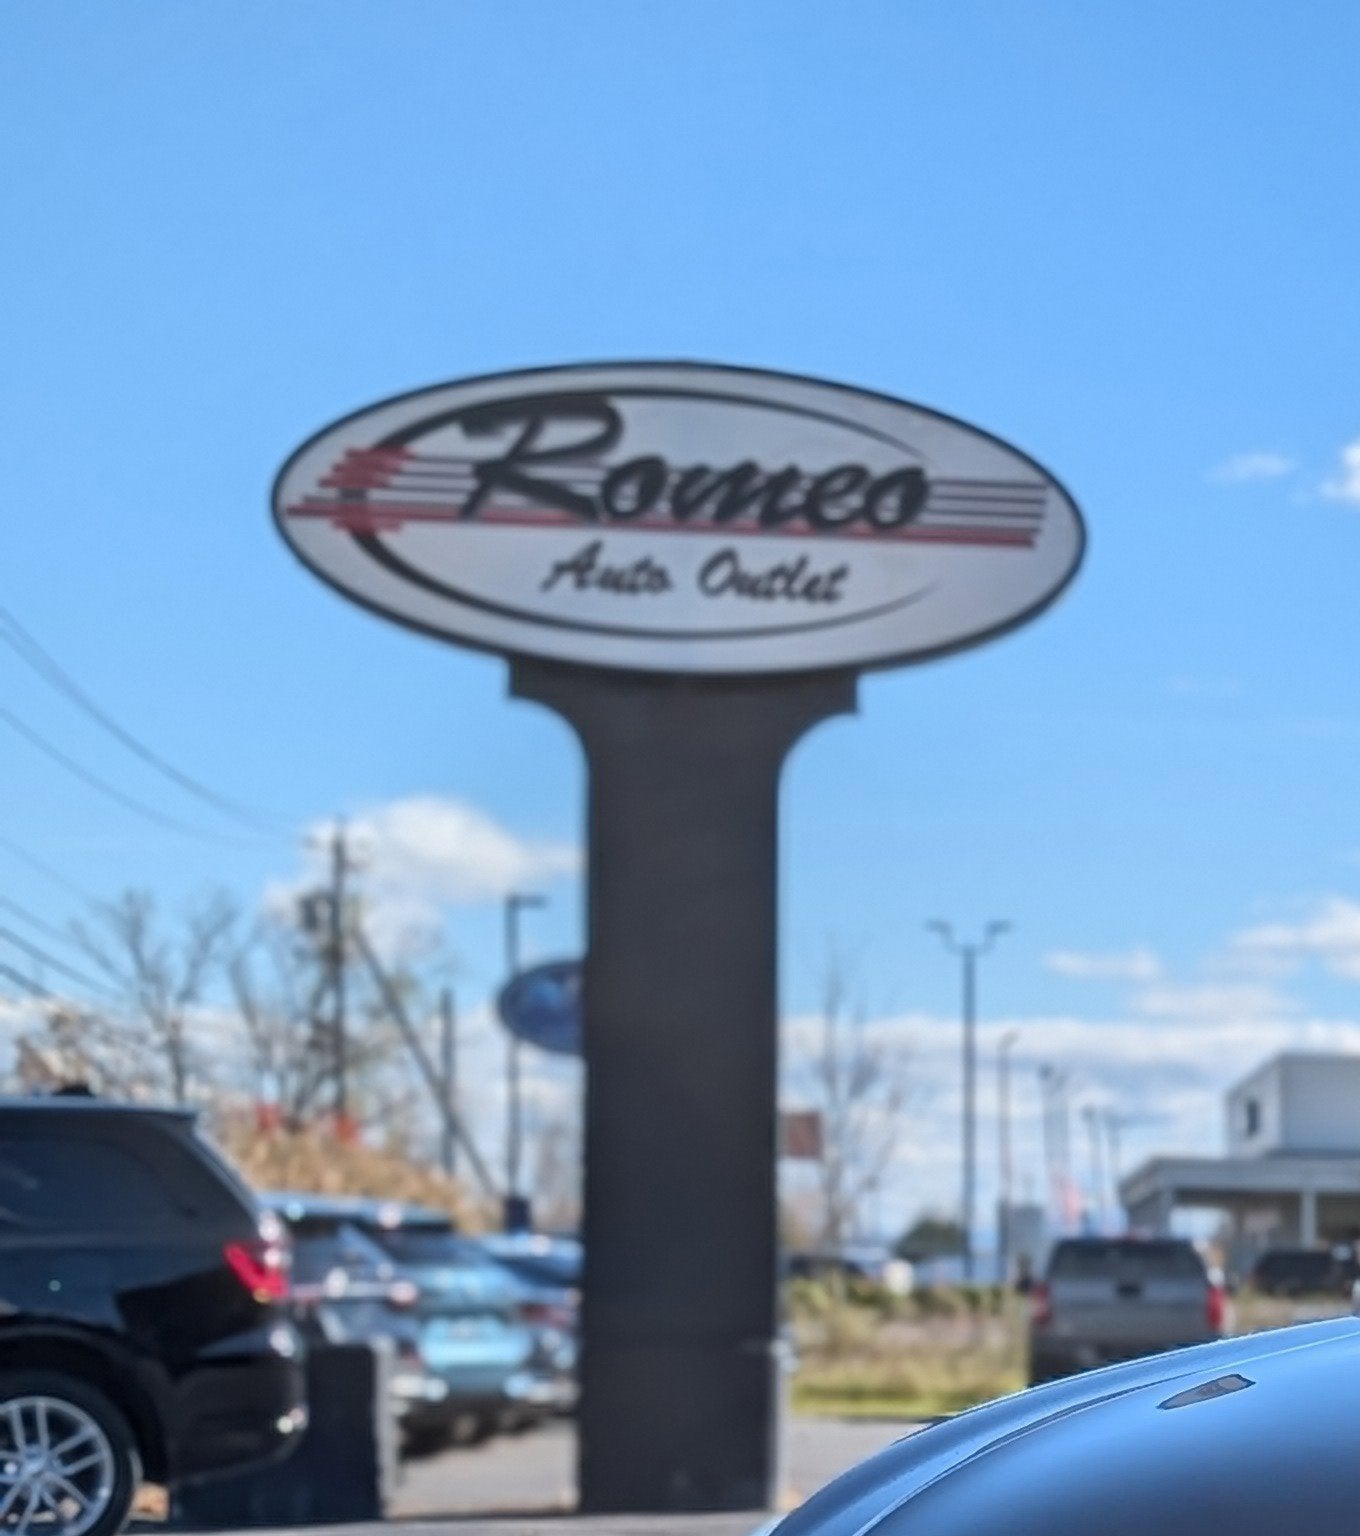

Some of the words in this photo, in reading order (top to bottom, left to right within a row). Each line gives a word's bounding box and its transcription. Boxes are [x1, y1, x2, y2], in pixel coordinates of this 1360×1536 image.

[457, 396, 930, 530] Romeo
[539, 538, 674, 594] Auto
[696, 546, 849, 604] Outlet
